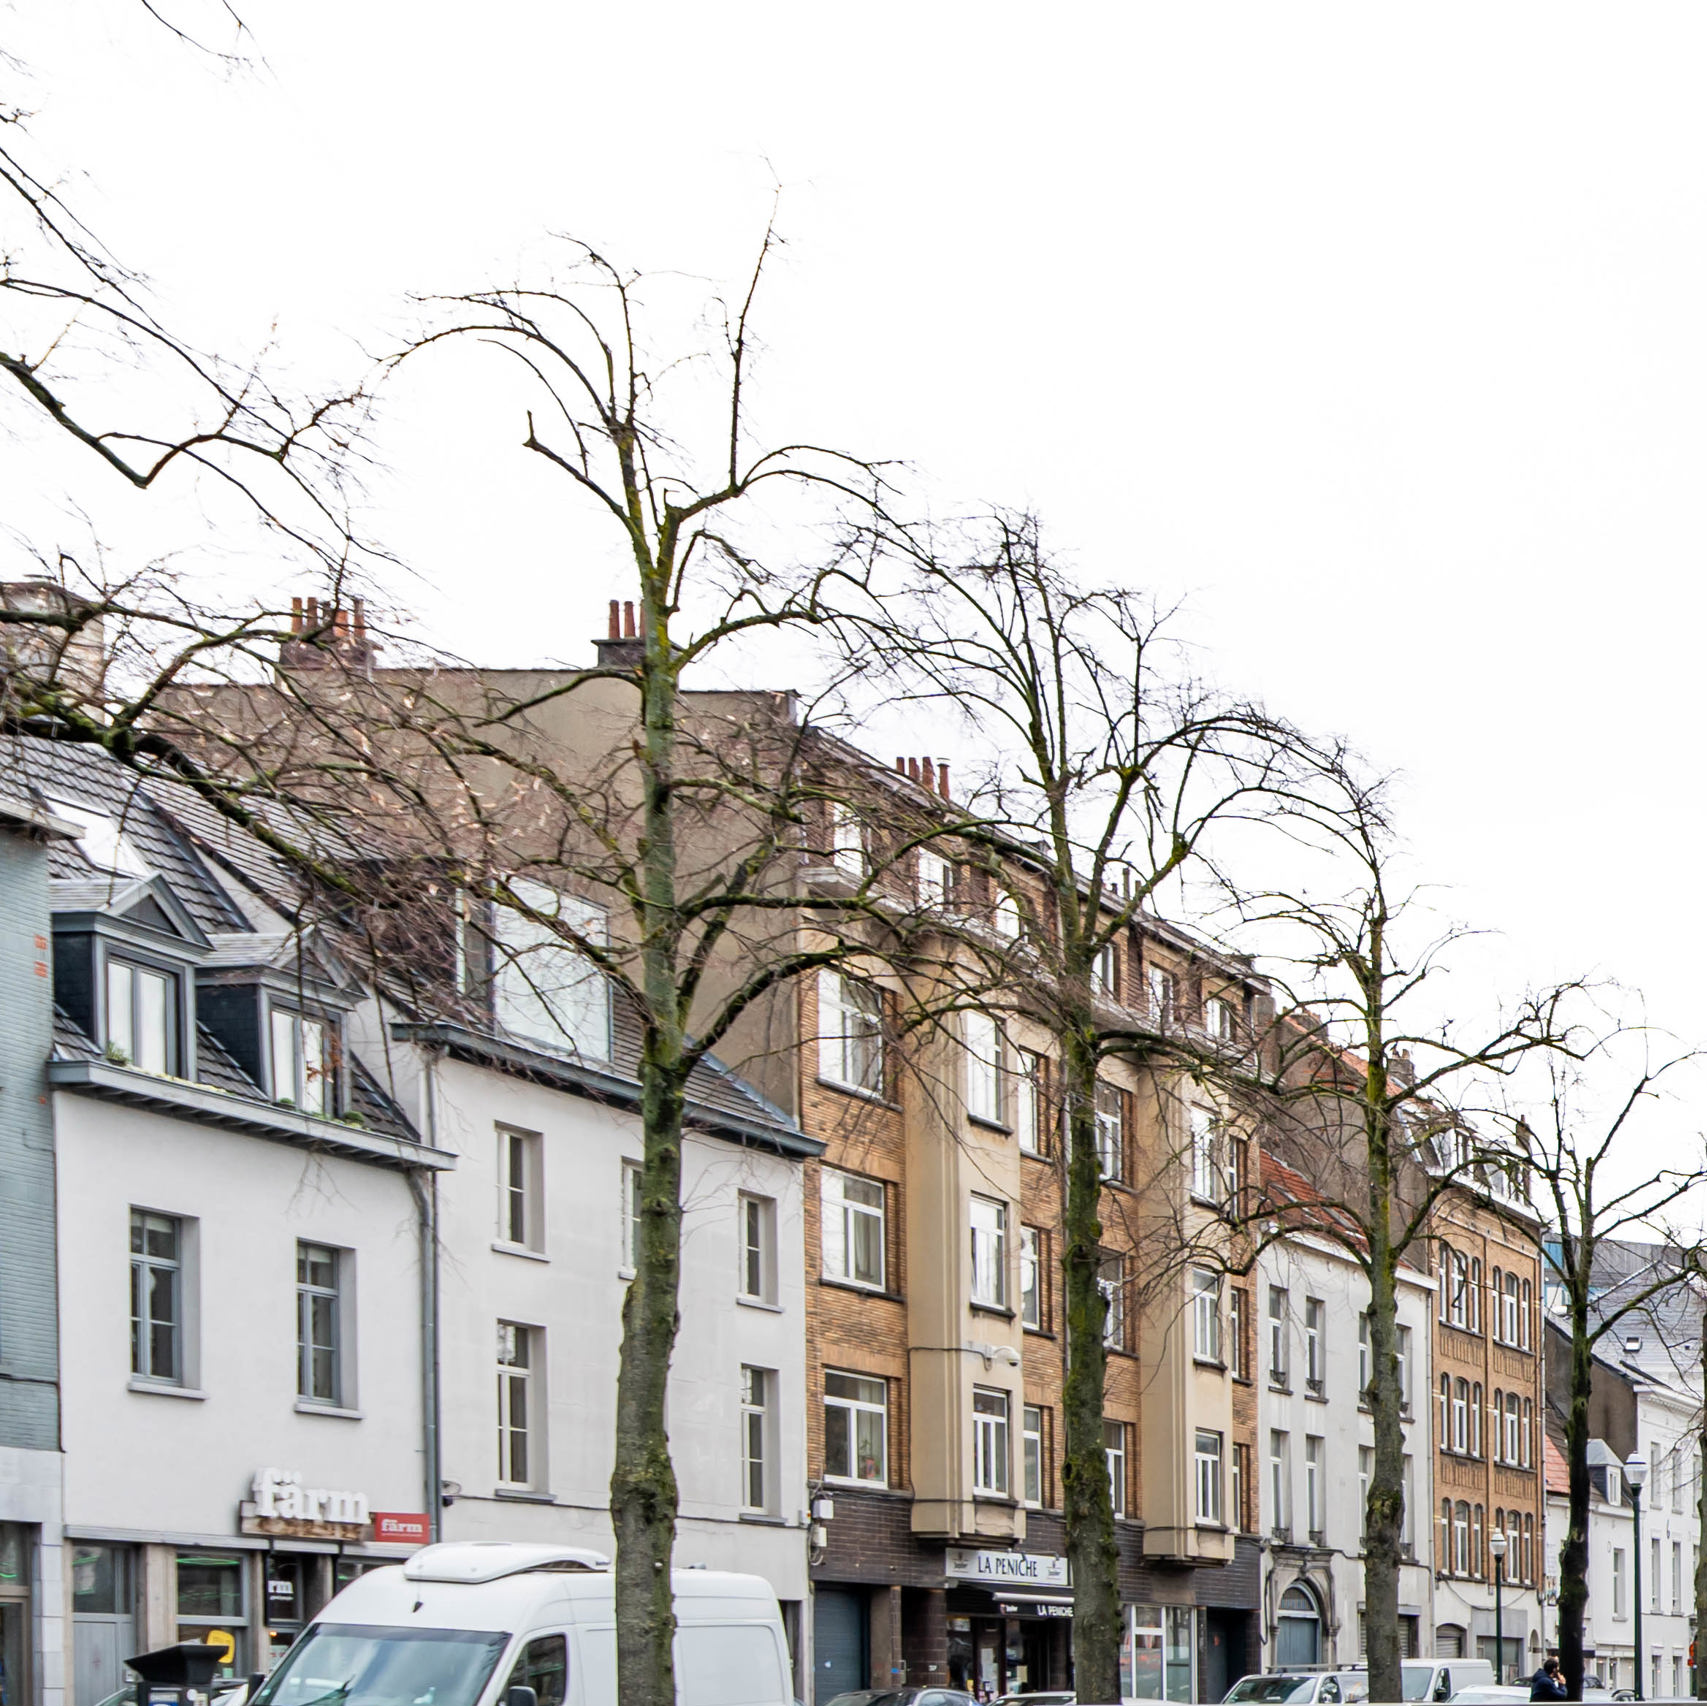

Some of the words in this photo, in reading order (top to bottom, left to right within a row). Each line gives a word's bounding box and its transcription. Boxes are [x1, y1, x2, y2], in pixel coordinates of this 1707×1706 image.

[253, 1467, 371, 1525] färm
[381, 1518, 423, 1533] färm
[978, 1556, 992, 1574] LA
[995, 1558, 1038, 1577] PENICHE
[1037, 1604, 1048, 1616] LA
[1048, 1605, 1074, 1618] PENICHE
